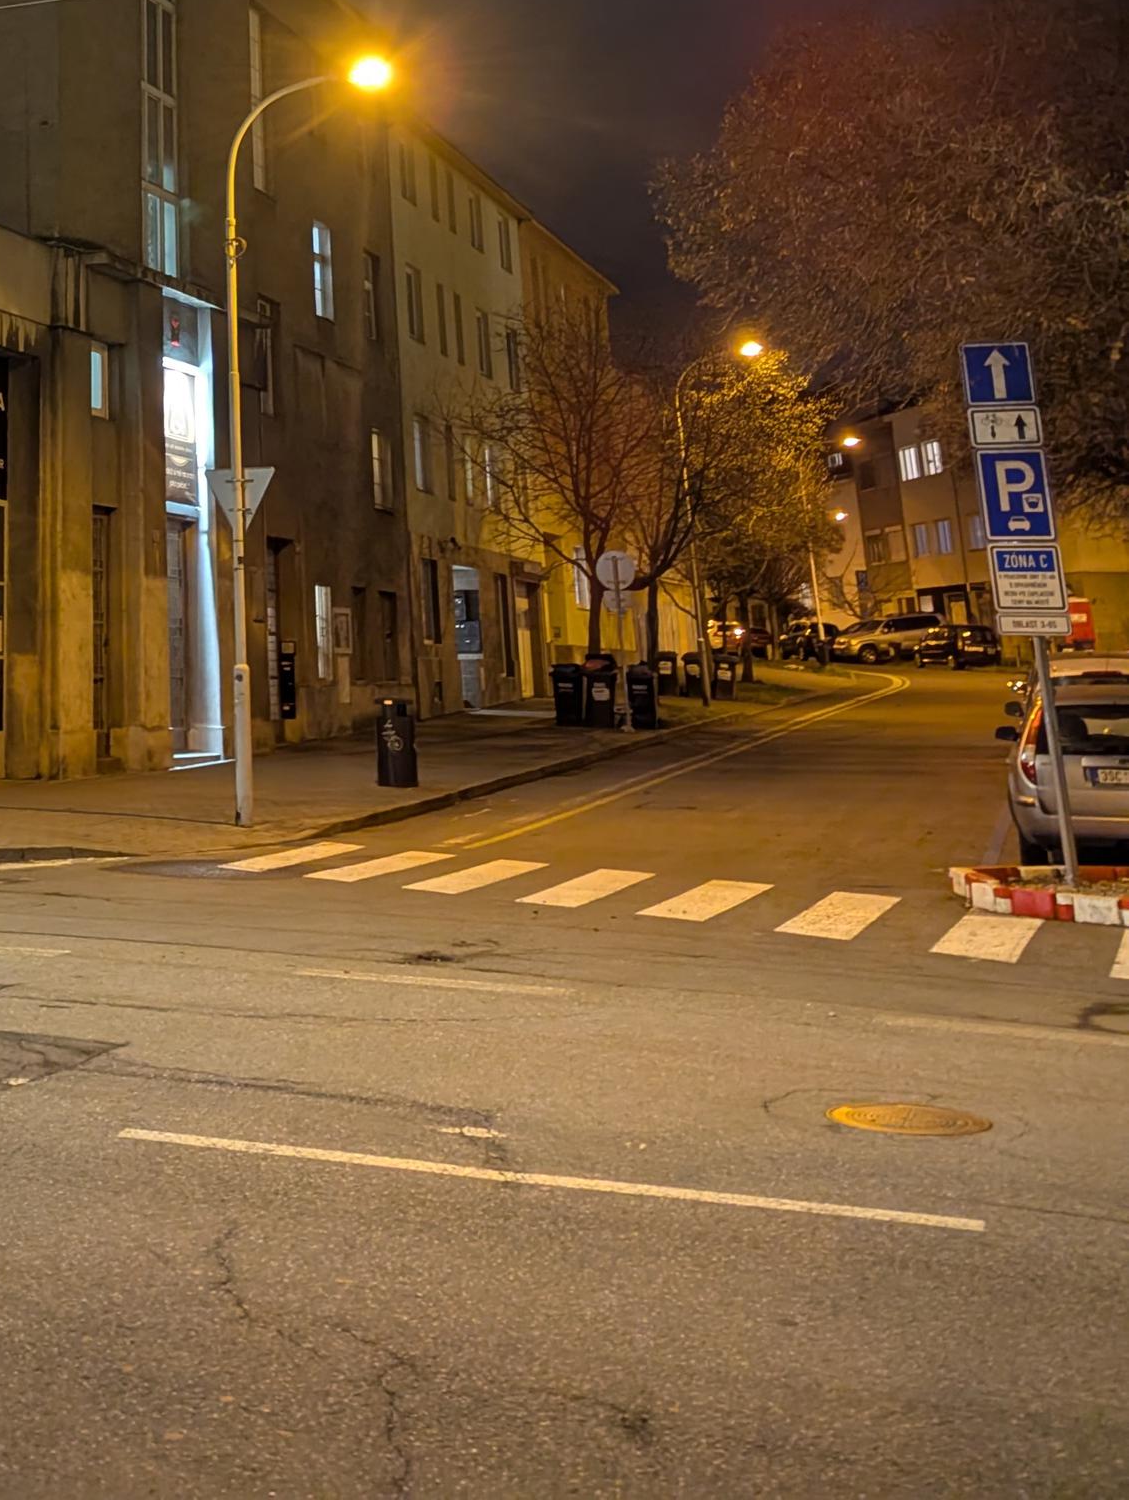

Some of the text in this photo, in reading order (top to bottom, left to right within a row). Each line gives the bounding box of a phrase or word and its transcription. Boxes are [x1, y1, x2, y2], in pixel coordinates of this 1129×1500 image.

[994, 460, 1035, 513] P
[1002, 552, 1048, 569] ZÓNA C
